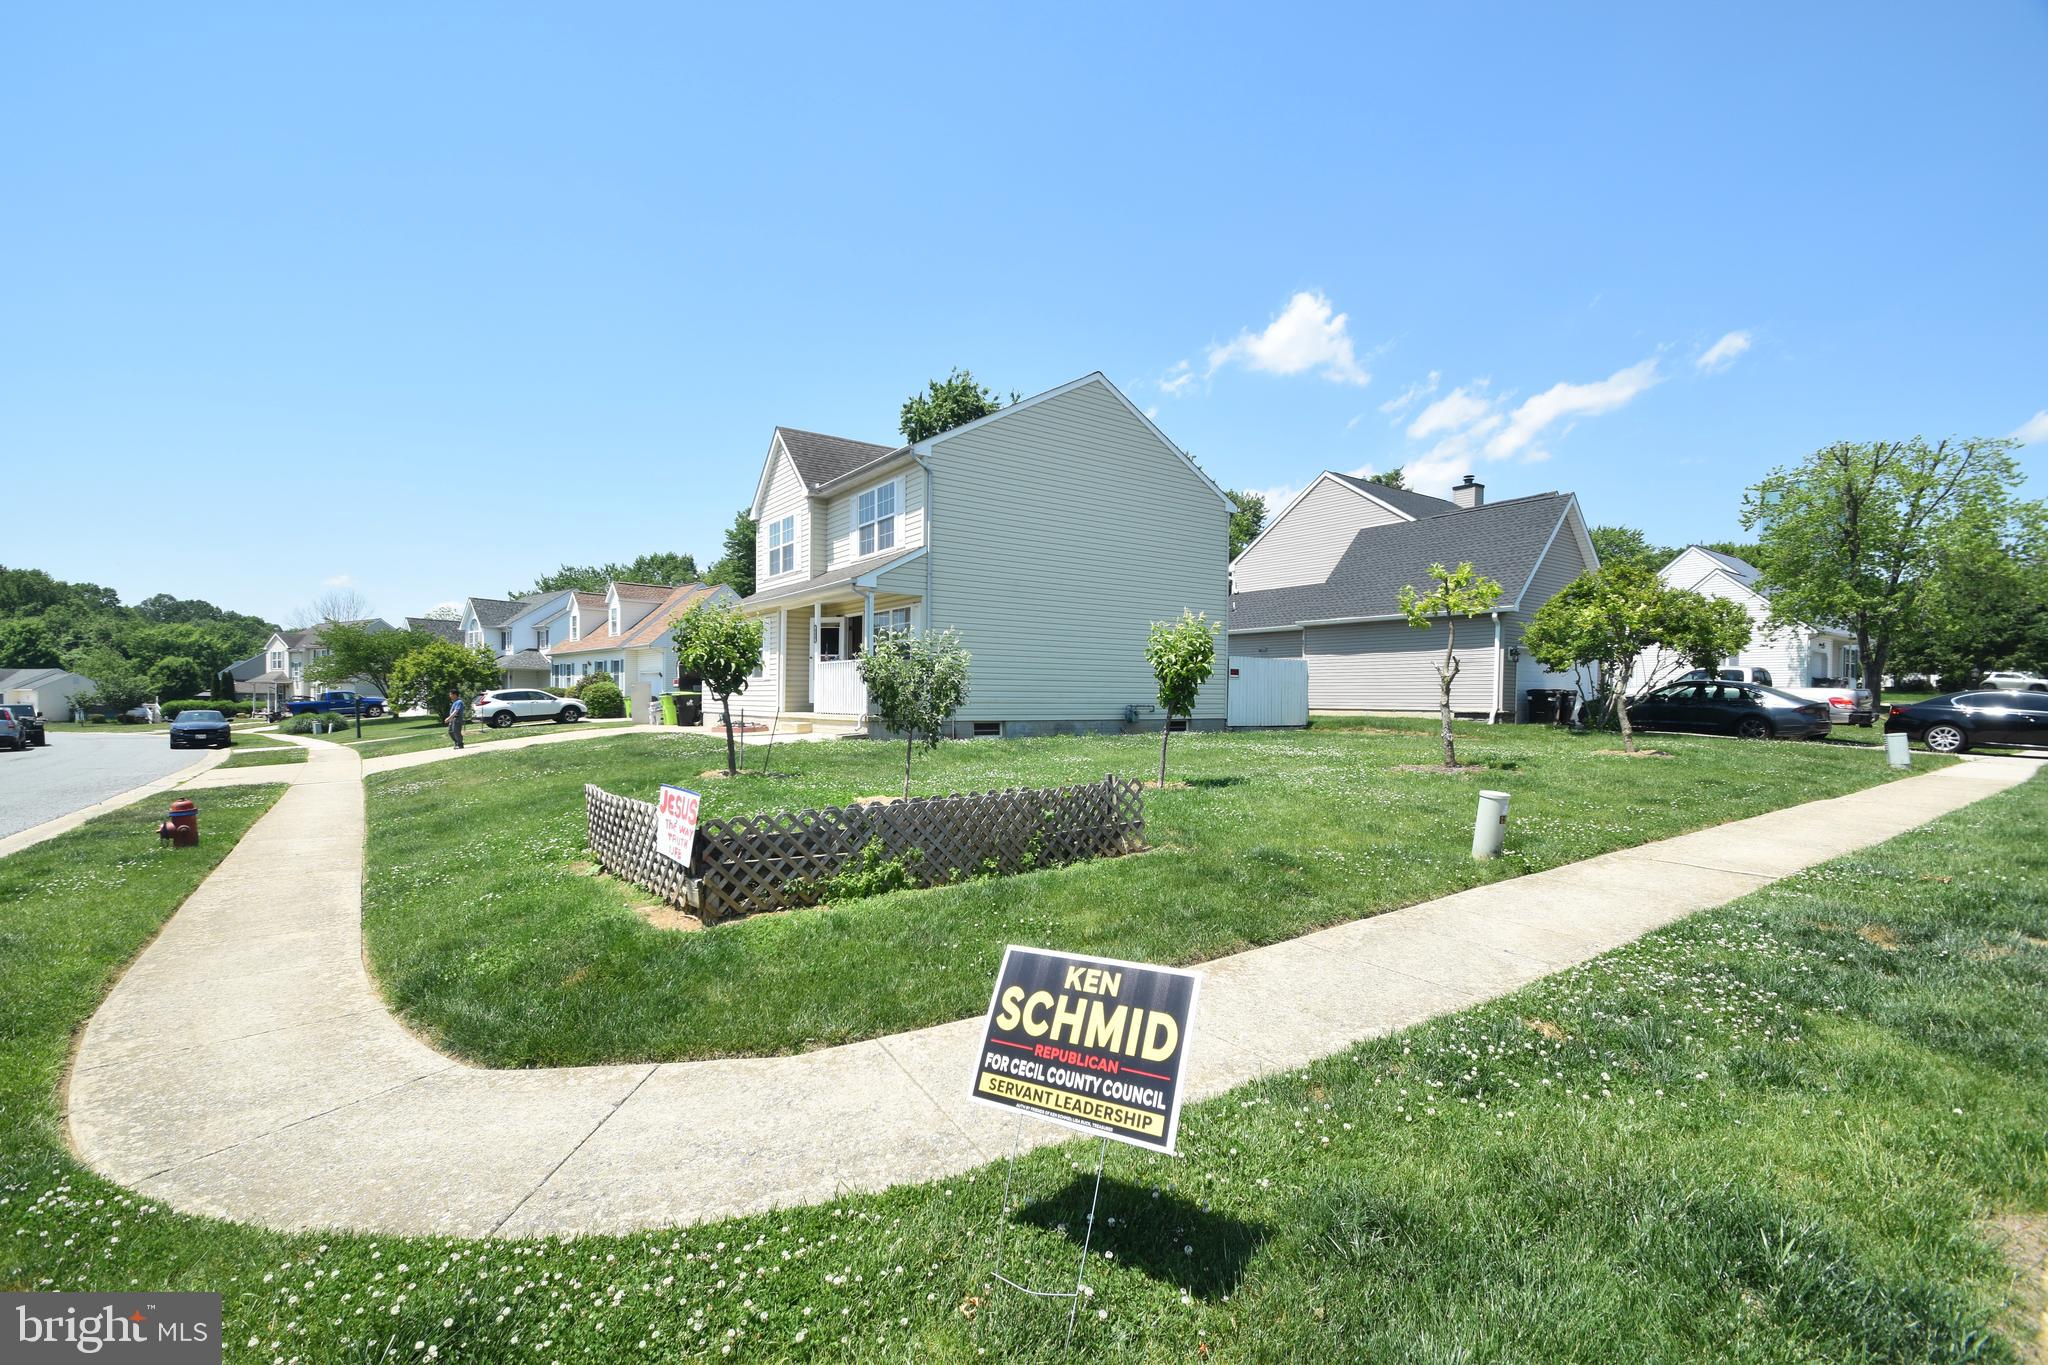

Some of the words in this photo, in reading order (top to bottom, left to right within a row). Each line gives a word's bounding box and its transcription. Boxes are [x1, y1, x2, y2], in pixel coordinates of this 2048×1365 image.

[679, 824, 694, 840] WAY
[1064, 965, 1122, 998] KEN
[996, 985, 1179, 1062] SCHMID
[1034, 1044, 1120, 1074] REPUBLICAN
[984, 1051, 1010, 1073] FOR
[1010, 1058, 1046, 1082] CECIL
[1046, 1066, 1103, 1094] COUNTY
[1102, 1079, 1166, 1111] COUNCIL
[988, 1078, 1053, 1105] SERVANT
[1054, 1093, 1153, 1130] LEADERSHIP
